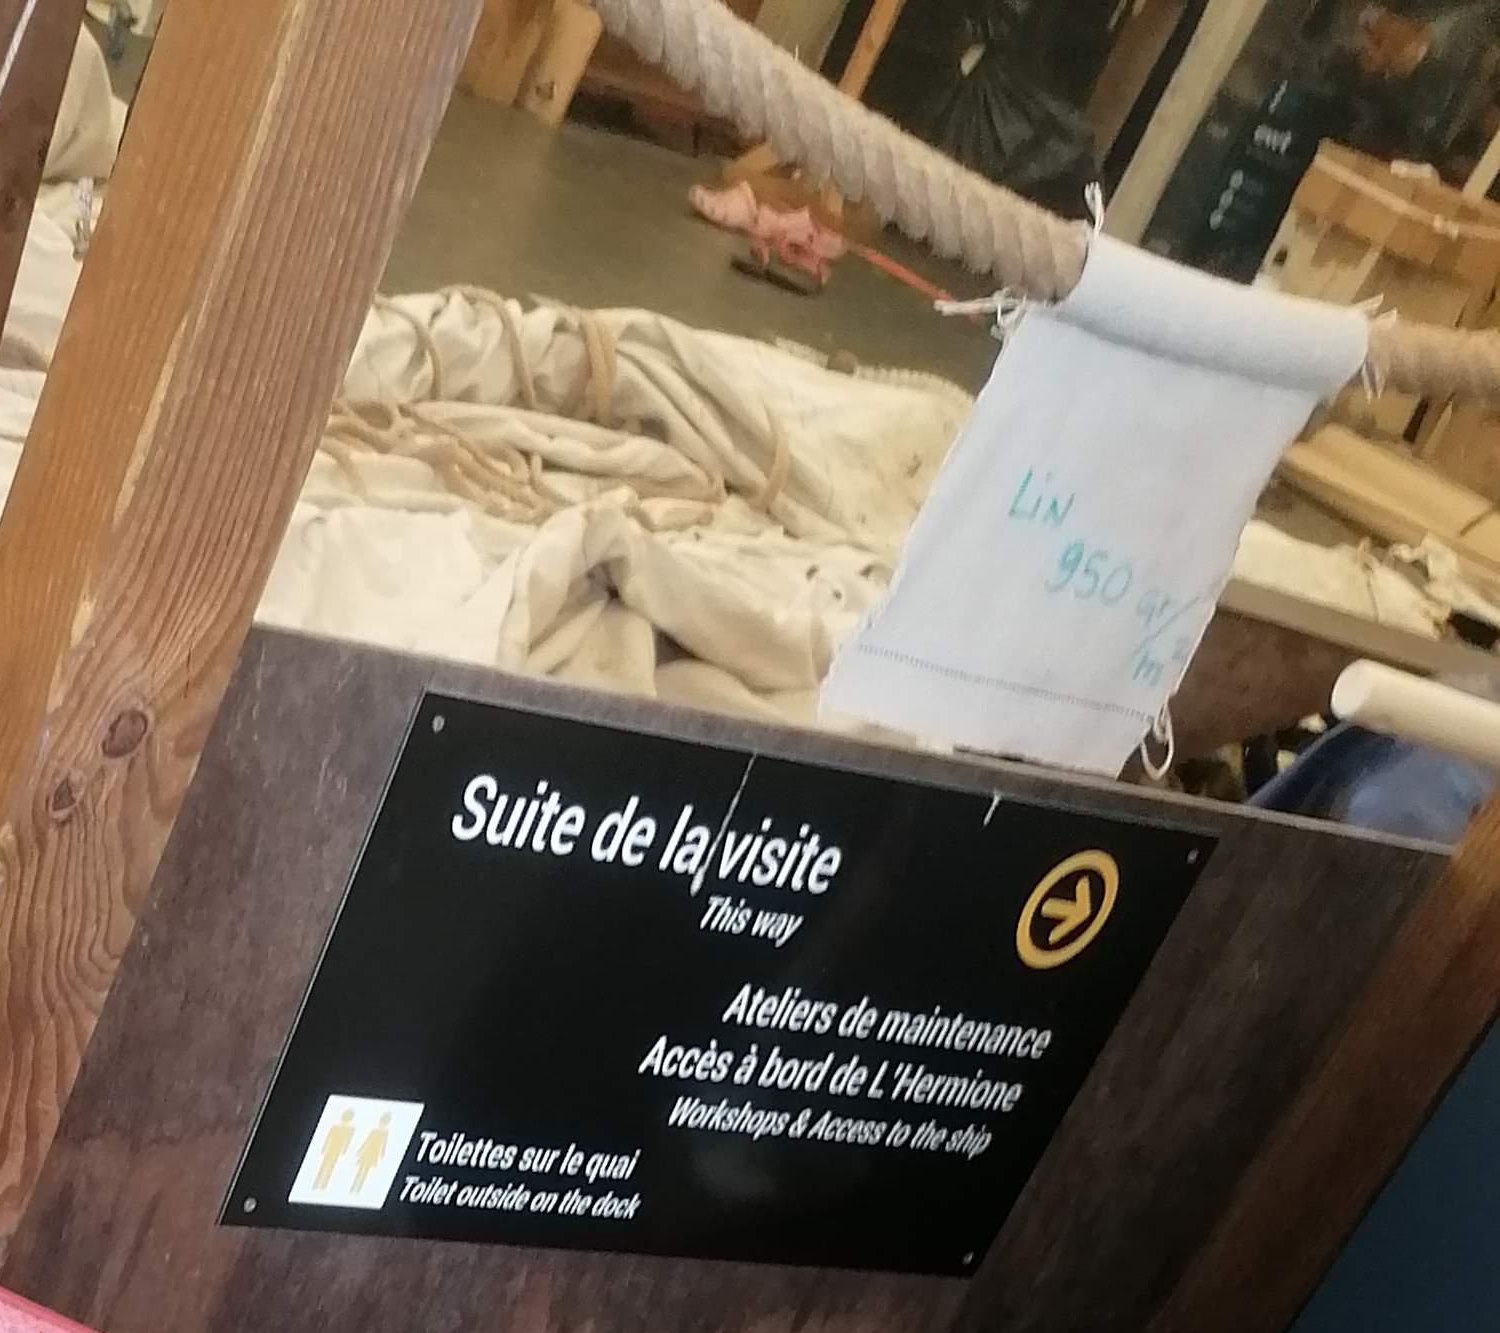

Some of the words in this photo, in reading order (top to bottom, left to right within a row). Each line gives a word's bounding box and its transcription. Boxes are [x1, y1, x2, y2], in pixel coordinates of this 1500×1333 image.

[1044, 538, 1133, 606] 950
[452, 773, 587, 856] Suite
[591, 795, 657, 867] de
[659, 804, 711, 875] la
[718, 818, 843, 895] visite
[699, 894, 753, 935] This
[751, 909, 804, 948] way
[721, 982, 839, 1035] Ateliers
[838, 996, 879, 1040] de
[876, 1005, 1053, 1059] maintenance
[638, 1035, 735, 1083] Accès
[733, 1043, 759, 1085] à
[757, 1045, 835, 1095] bord
[828, 1054, 869, 1097] de
[867, 1060, 1026, 1113] L'Hermione
[416, 1130, 518, 1171] Toilettes
[518, 1147, 562, 1173] sur
[559, 1142, 585, 1176] le
[585, 1148, 642, 1185] quai
[668, 1096, 792, 1140] Workshops
[788, 1107, 809, 1138] &
[807, 1110, 887, 1146] Access
[885, 1118, 910, 1147] to
[909, 1119, 946, 1152] the
[944, 1124, 993, 1161] ship
[399, 1175, 458, 1206] Toilet
[456, 1182, 531, 1211] outside
[530, 1190, 559, 1214] on
[557, 1187, 592, 1216] the
[591, 1190, 642, 1220] dock
